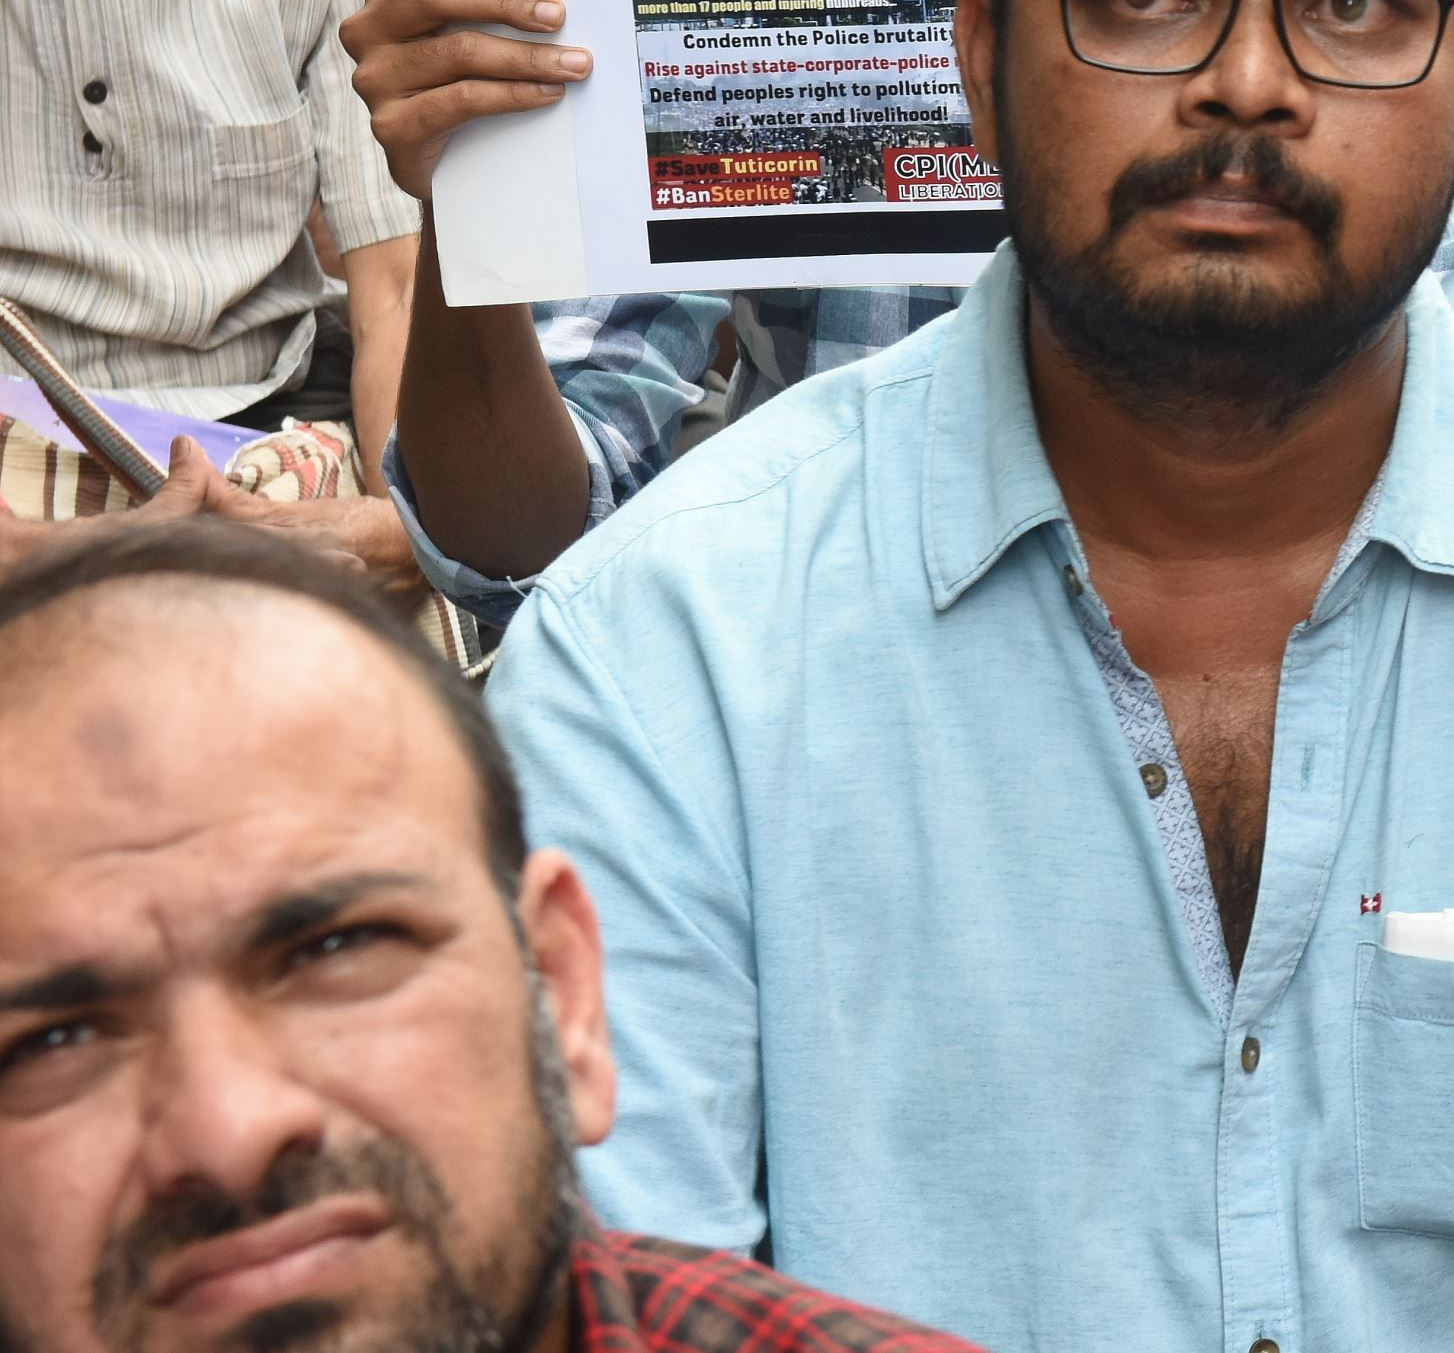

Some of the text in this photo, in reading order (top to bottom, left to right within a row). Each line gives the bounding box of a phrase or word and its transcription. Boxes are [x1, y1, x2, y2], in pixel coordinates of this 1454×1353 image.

[684, 33, 771, 49] Condemn
[777, 32, 808, 46] the
[813, 30, 869, 45] Police
[655, 156, 818, 176] #SaveTuticorin
[656, 185, 791, 204] #BanSterlite
